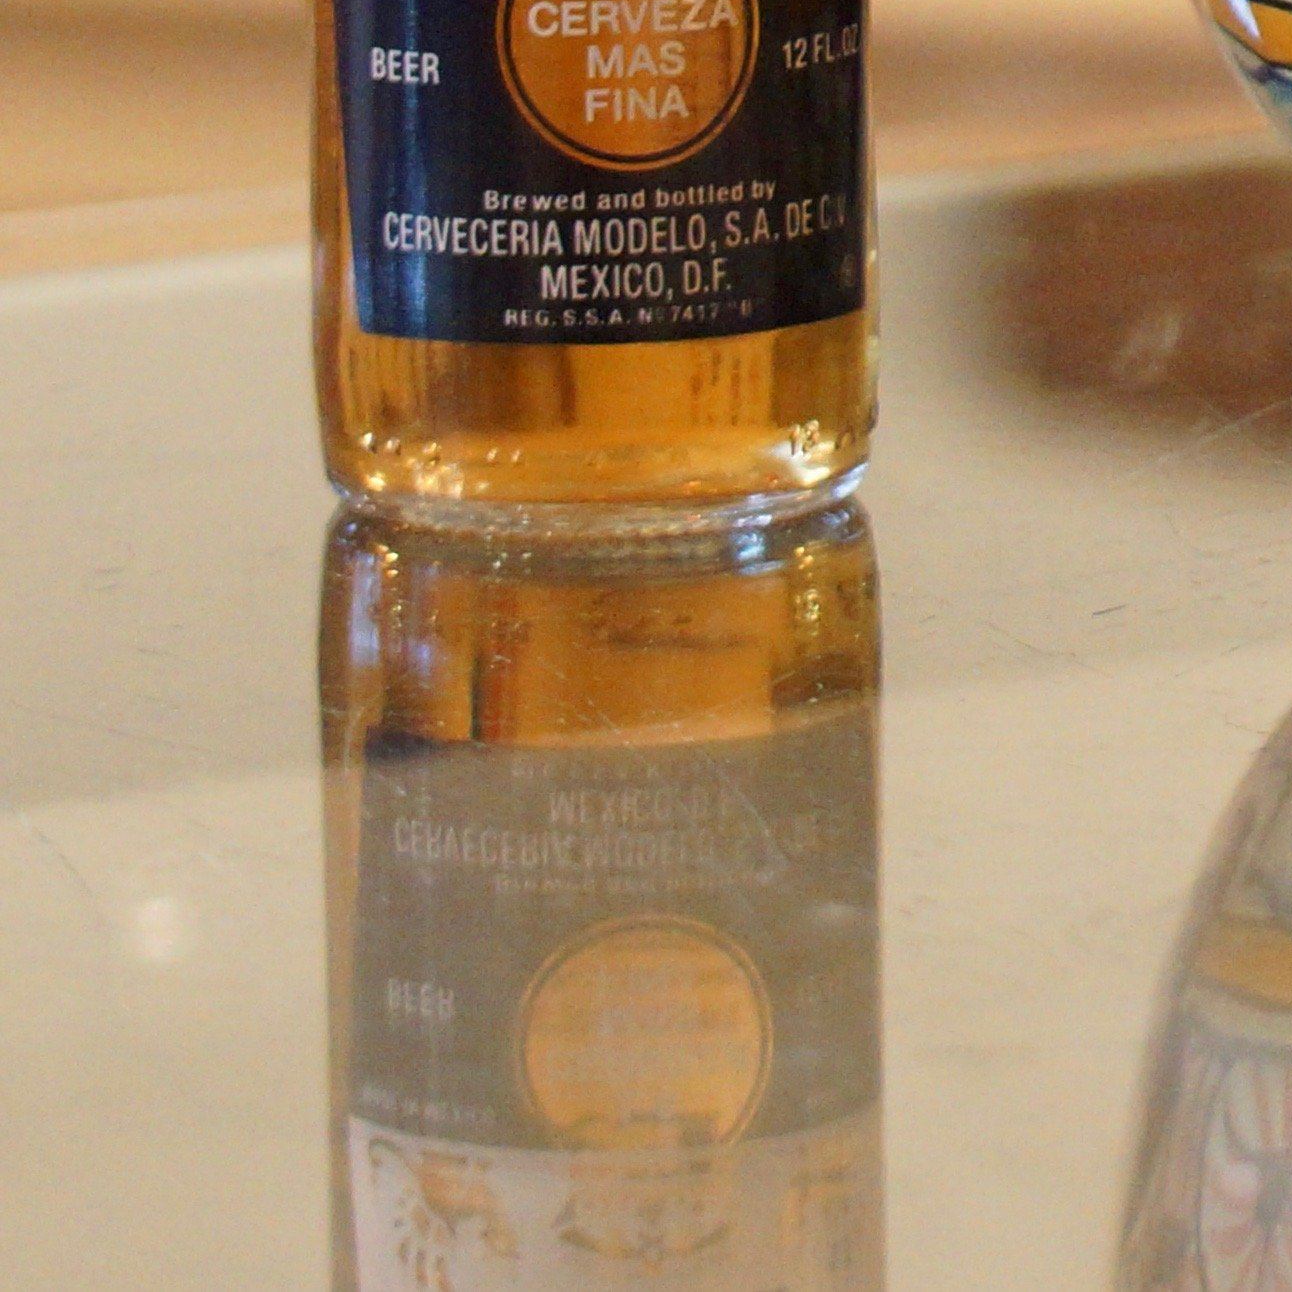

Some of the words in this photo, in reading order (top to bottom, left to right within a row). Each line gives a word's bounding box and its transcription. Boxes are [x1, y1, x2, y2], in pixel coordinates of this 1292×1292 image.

[370, 46, 440, 86] BEER
[586, 39, 688, 80] MAS
[782, 36, 808, 70] 12
[584, 83, 690, 124] FINA
[483, 188, 587, 212] Brewed
[596, 188, 646, 211] and
[654, 181, 744, 209] bottled
[750, 178, 777, 202] by
[382, 211, 565, 257] CERVECERIA
[573, 213, 718, 257] MODELO,
[785, 198, 814, 241] DE
[539, 261, 674, 302] MEXICO,
[682, 256, 733, 297] D.F.
